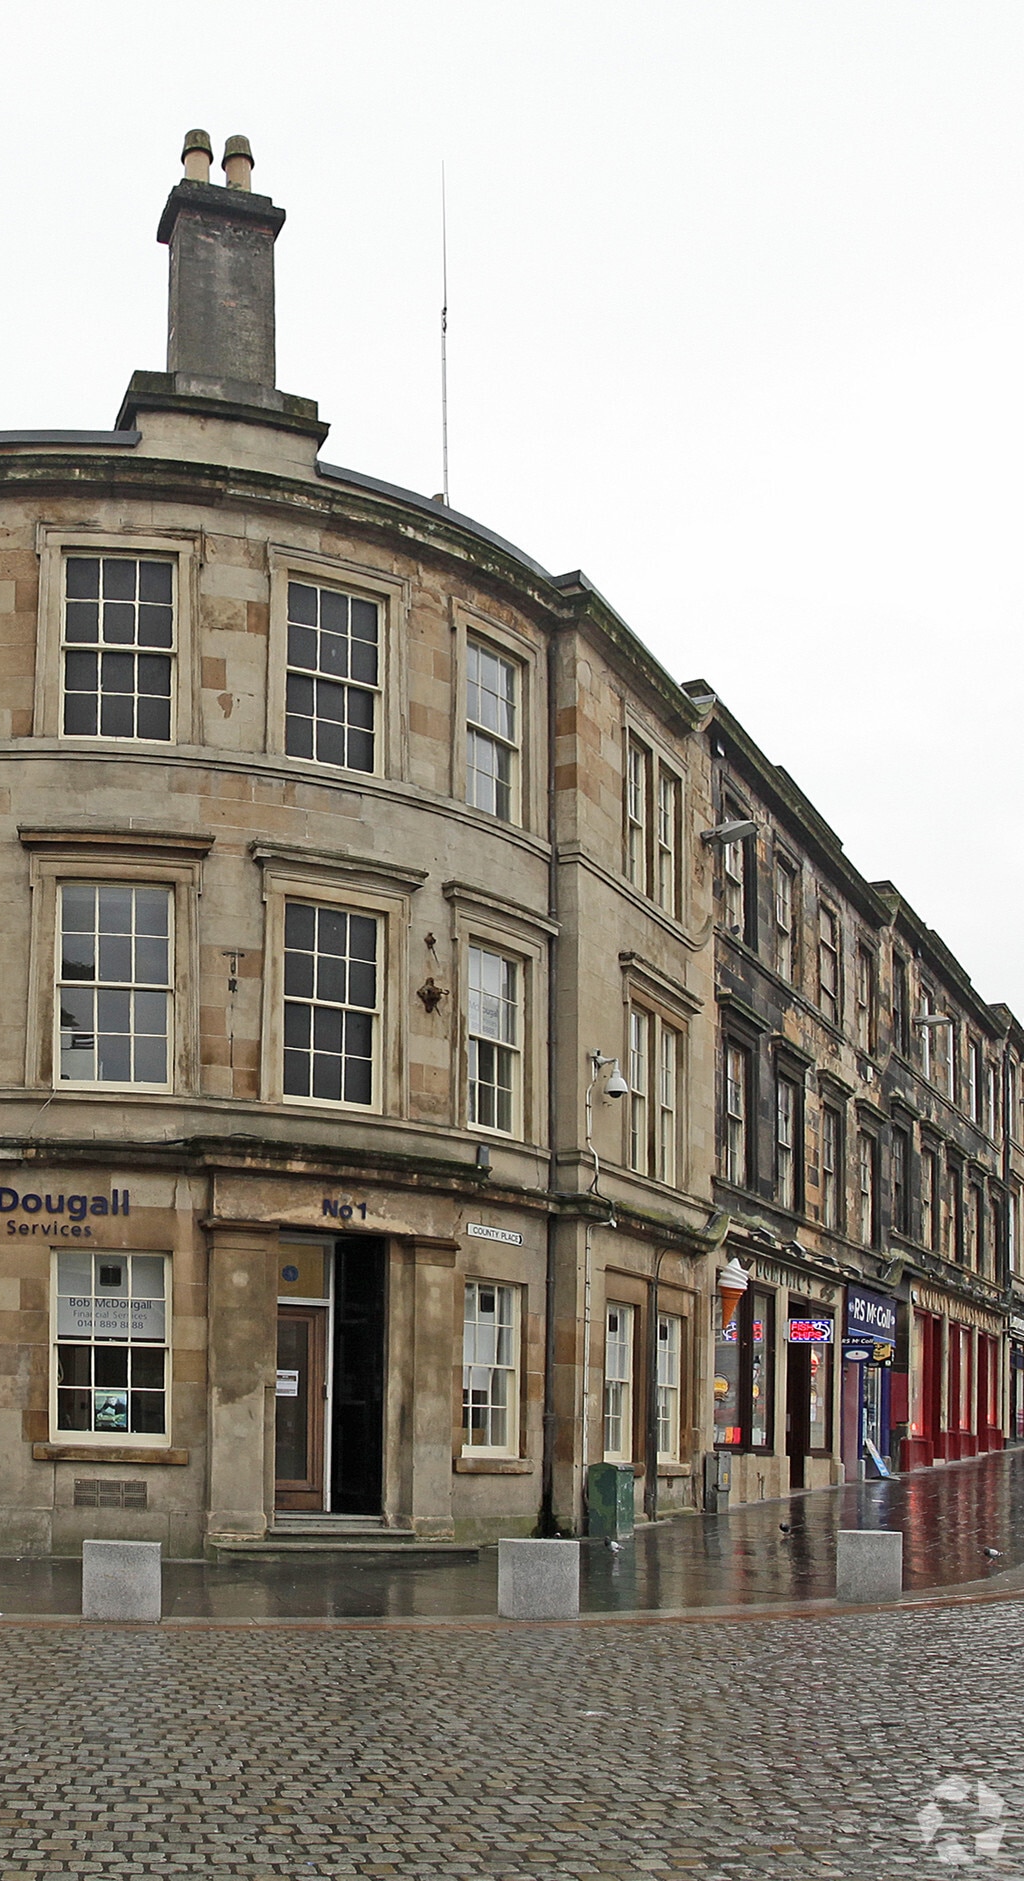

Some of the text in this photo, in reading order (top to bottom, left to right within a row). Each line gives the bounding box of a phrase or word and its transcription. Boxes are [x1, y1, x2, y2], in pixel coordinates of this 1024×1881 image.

[322, 1199, 367, 1220] No 1
[7, 1219, 92, 1237] Services
[473, 1226, 519, 1243] COUNTY PLACE
[69, 1297, 90, 1307] Bob
[853, 1297, 866, 1321] RS
[99, 1320, 117, 1329] 889
[791, 1323, 814, 1331] FISH
[791, 1331, 823, 1339] CHIPS
